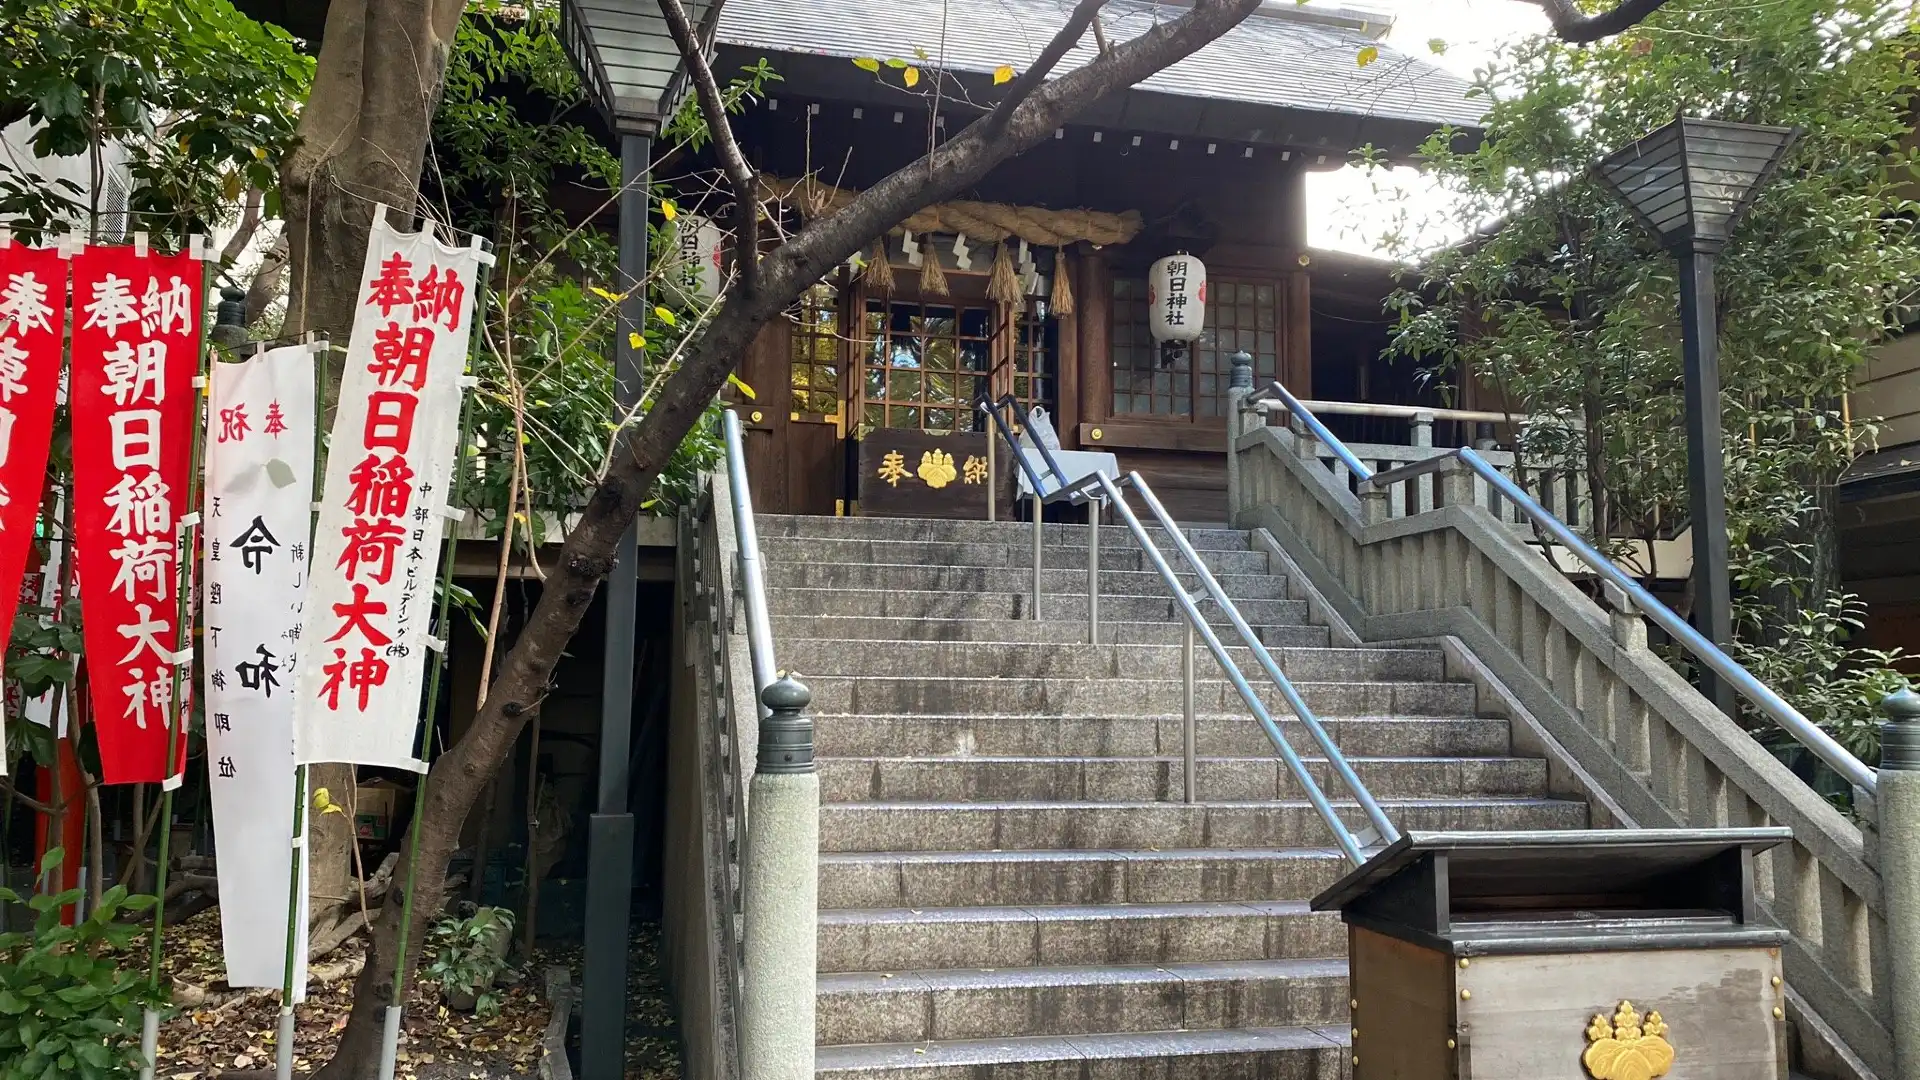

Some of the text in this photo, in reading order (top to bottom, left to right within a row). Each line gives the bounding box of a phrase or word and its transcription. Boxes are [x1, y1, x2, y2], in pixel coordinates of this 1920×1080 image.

[83, 272, 192, 338] 奉納
[367, 252, 465, 333] 奉納
[1165, 260, 1188, 325] 朝日神社
[101, 340, 173, 730] 朝日稲荷大神
[319, 321, 436, 711] 朝日稲荷大神
